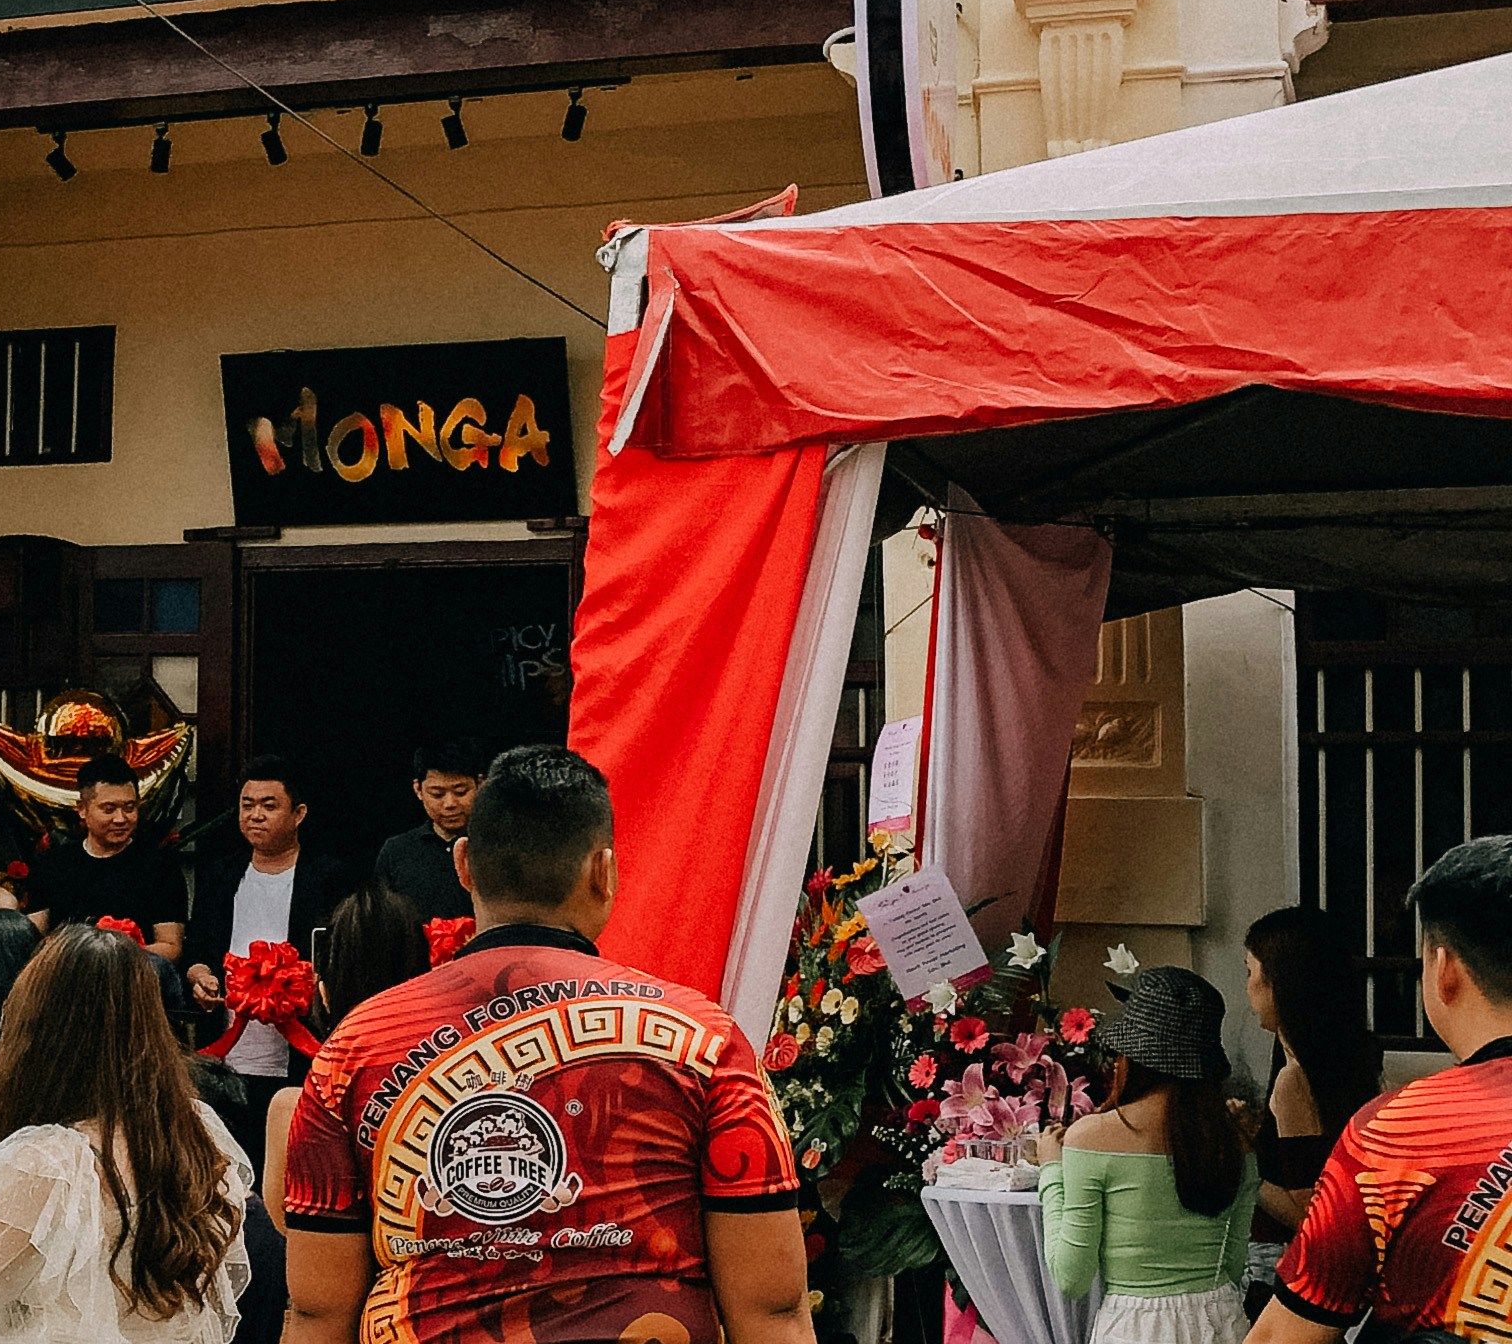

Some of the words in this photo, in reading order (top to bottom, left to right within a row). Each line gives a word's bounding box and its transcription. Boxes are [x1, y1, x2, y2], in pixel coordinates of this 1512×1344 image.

[247, 387, 550, 483] MONGA
[357, 1024, 462, 1150] PENANG
[463, 979, 664, 1033] FORWARD
[446, 1155, 502, 1188] COFFEE
[508, 1156, 548, 1188] TREE
[457, 1187, 498, 1208] PREMIUM
[499, 1185, 536, 1208] QUALITY
[551, 1223, 634, 1249] Coffee
